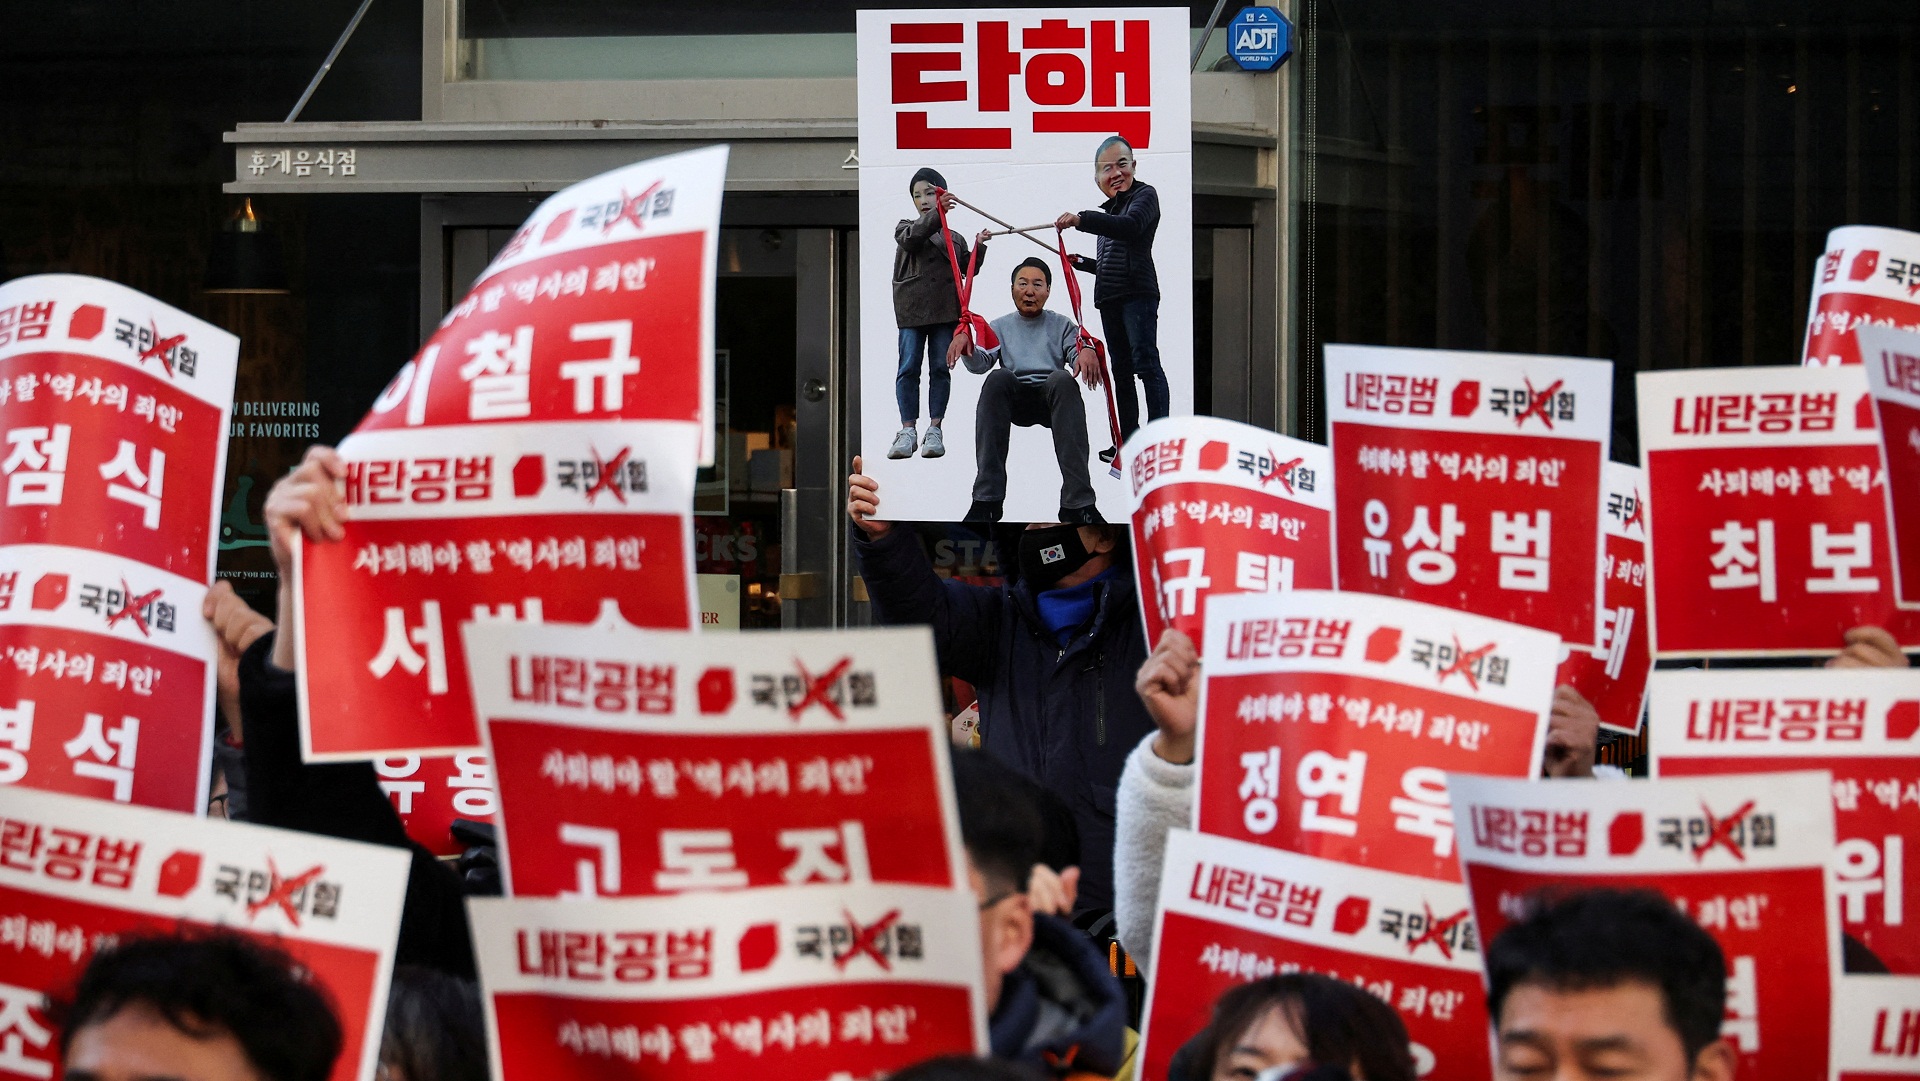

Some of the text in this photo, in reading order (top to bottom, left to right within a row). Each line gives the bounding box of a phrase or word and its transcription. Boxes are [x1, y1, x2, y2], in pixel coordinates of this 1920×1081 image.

[1236, 28, 1277, 50] ADT
[890, 19, 1150, 149] 탄핵
[248, 149, 357, 176] 휴게음식점
[593, 257, 656, 294] 죄인'
[43, 372, 128, 413] '역사의
[133, 394, 183, 434] 죄인'
[244, 402, 319, 417] DELIVERING
[1345, 373, 1438, 415] 내란공범
[1673, 393, 1837, 435] 내란공범
[250, 424, 319, 438] FAVORITES
[1409, 450, 1431, 479] 할
[1434, 453, 1508, 483] '역사의
[1514, 457, 1566, 487] 죄인'
[1699, 468, 1802, 497] 사퇴해야
[1808, 466, 1833, 496] 할
[1181, 500, 1254, 530] '역사의
[1257, 510, 1307, 541] 죄인'
[243, 571, 259, 580] you
[353, 536, 647, 576] 사퇴해야 할 '역사의 죄인'
[1226, 617, 1352, 661] 내란공범
[100, 660, 162, 695] 죄인'
[510, 655, 676, 715] 내란공범
[1307, 693, 1333, 723] 할
[1337, 696, 1424, 738] '역사의
[1428, 715, 1490, 750] 죄인'
[1686, 698, 1868, 742] 내란공범
[680, 755, 790, 799] '역사의
[799, 754, 874, 795] 죄인'
[1470, 803, 1590, 858] 내란공범
[1190, 862, 1321, 927] 내란공범
[517, 928, 713, 983] 내란공범
[718, 1007, 831, 1057] '역사의
[839, 1004, 917, 1046] 죄인'
